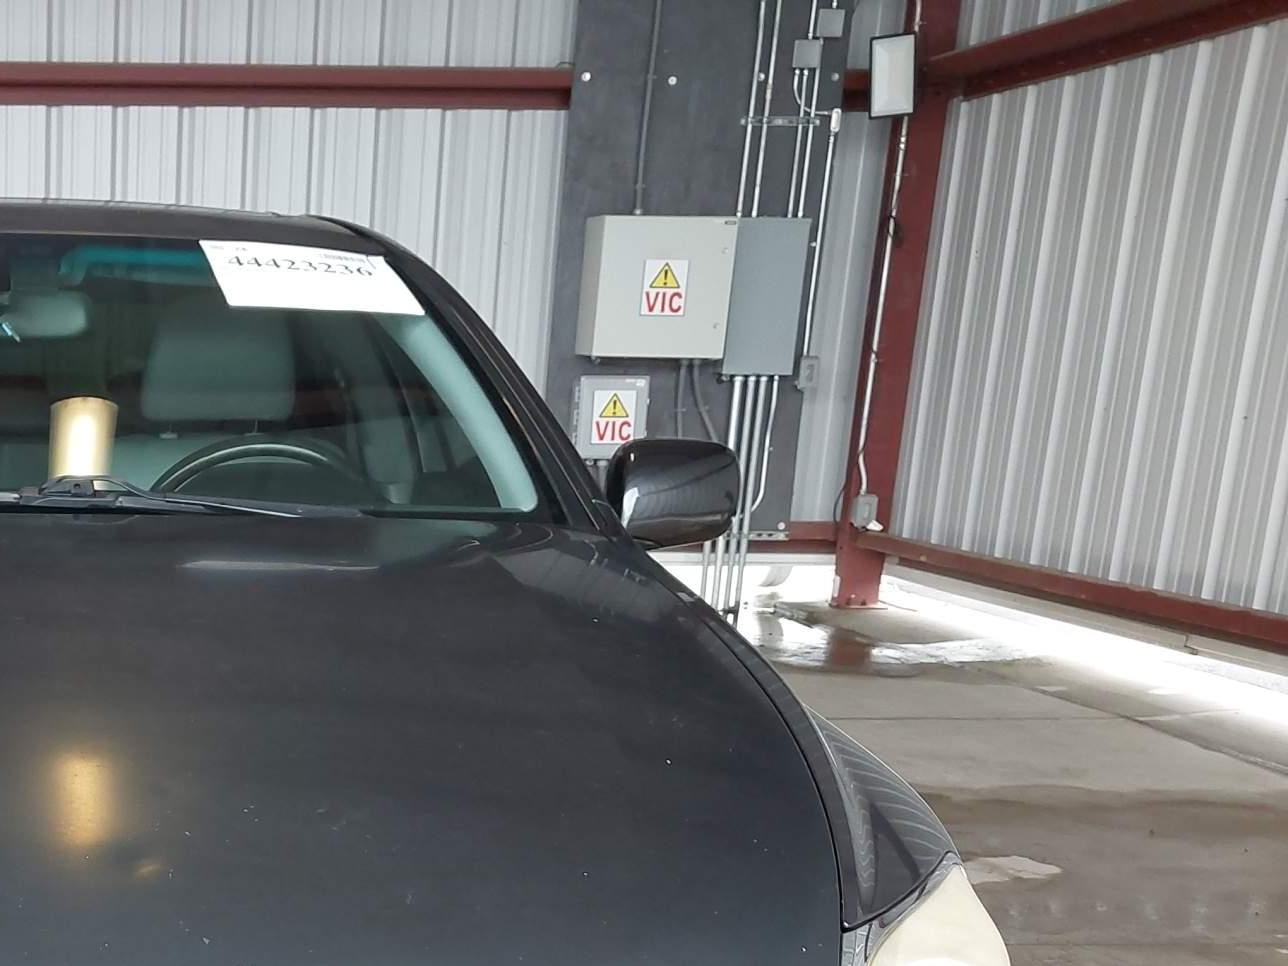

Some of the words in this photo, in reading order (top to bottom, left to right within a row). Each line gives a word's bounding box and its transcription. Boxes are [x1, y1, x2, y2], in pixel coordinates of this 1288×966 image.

[228, 254, 373, 277] 44423236
[644, 290, 683, 313] VIC
[595, 420, 632, 441] VIC
